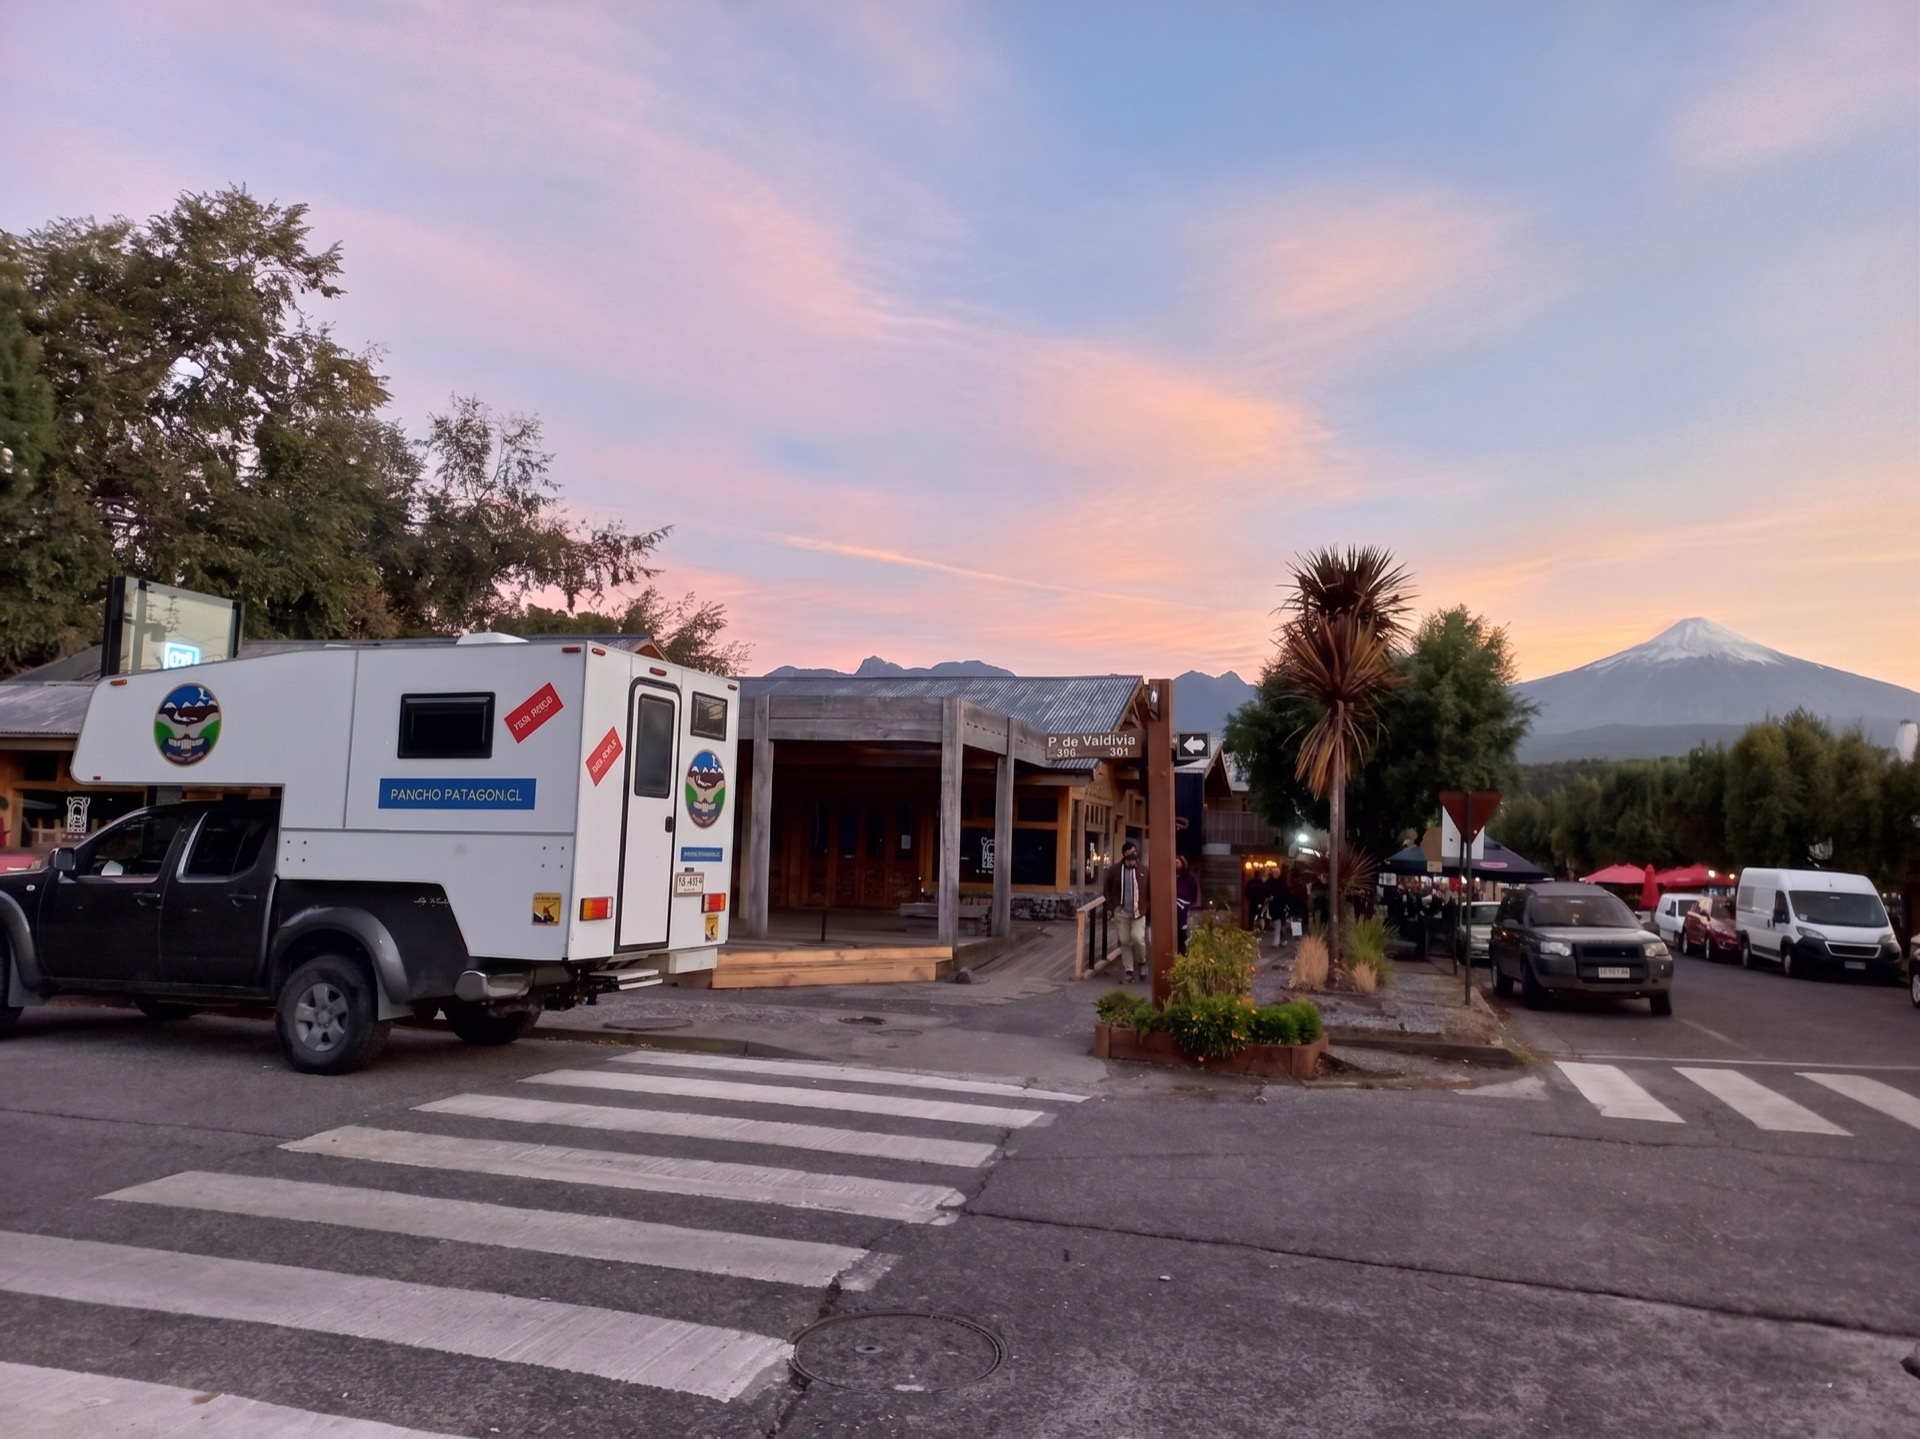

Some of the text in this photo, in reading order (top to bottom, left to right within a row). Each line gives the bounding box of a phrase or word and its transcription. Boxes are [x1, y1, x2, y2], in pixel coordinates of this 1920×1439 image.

[1047, 734, 1136, 747] P de Valdivia
[1056, 747, 1129, 758] 396 301
[390, 788, 522, 802] PANCHO PATAGON.CL
